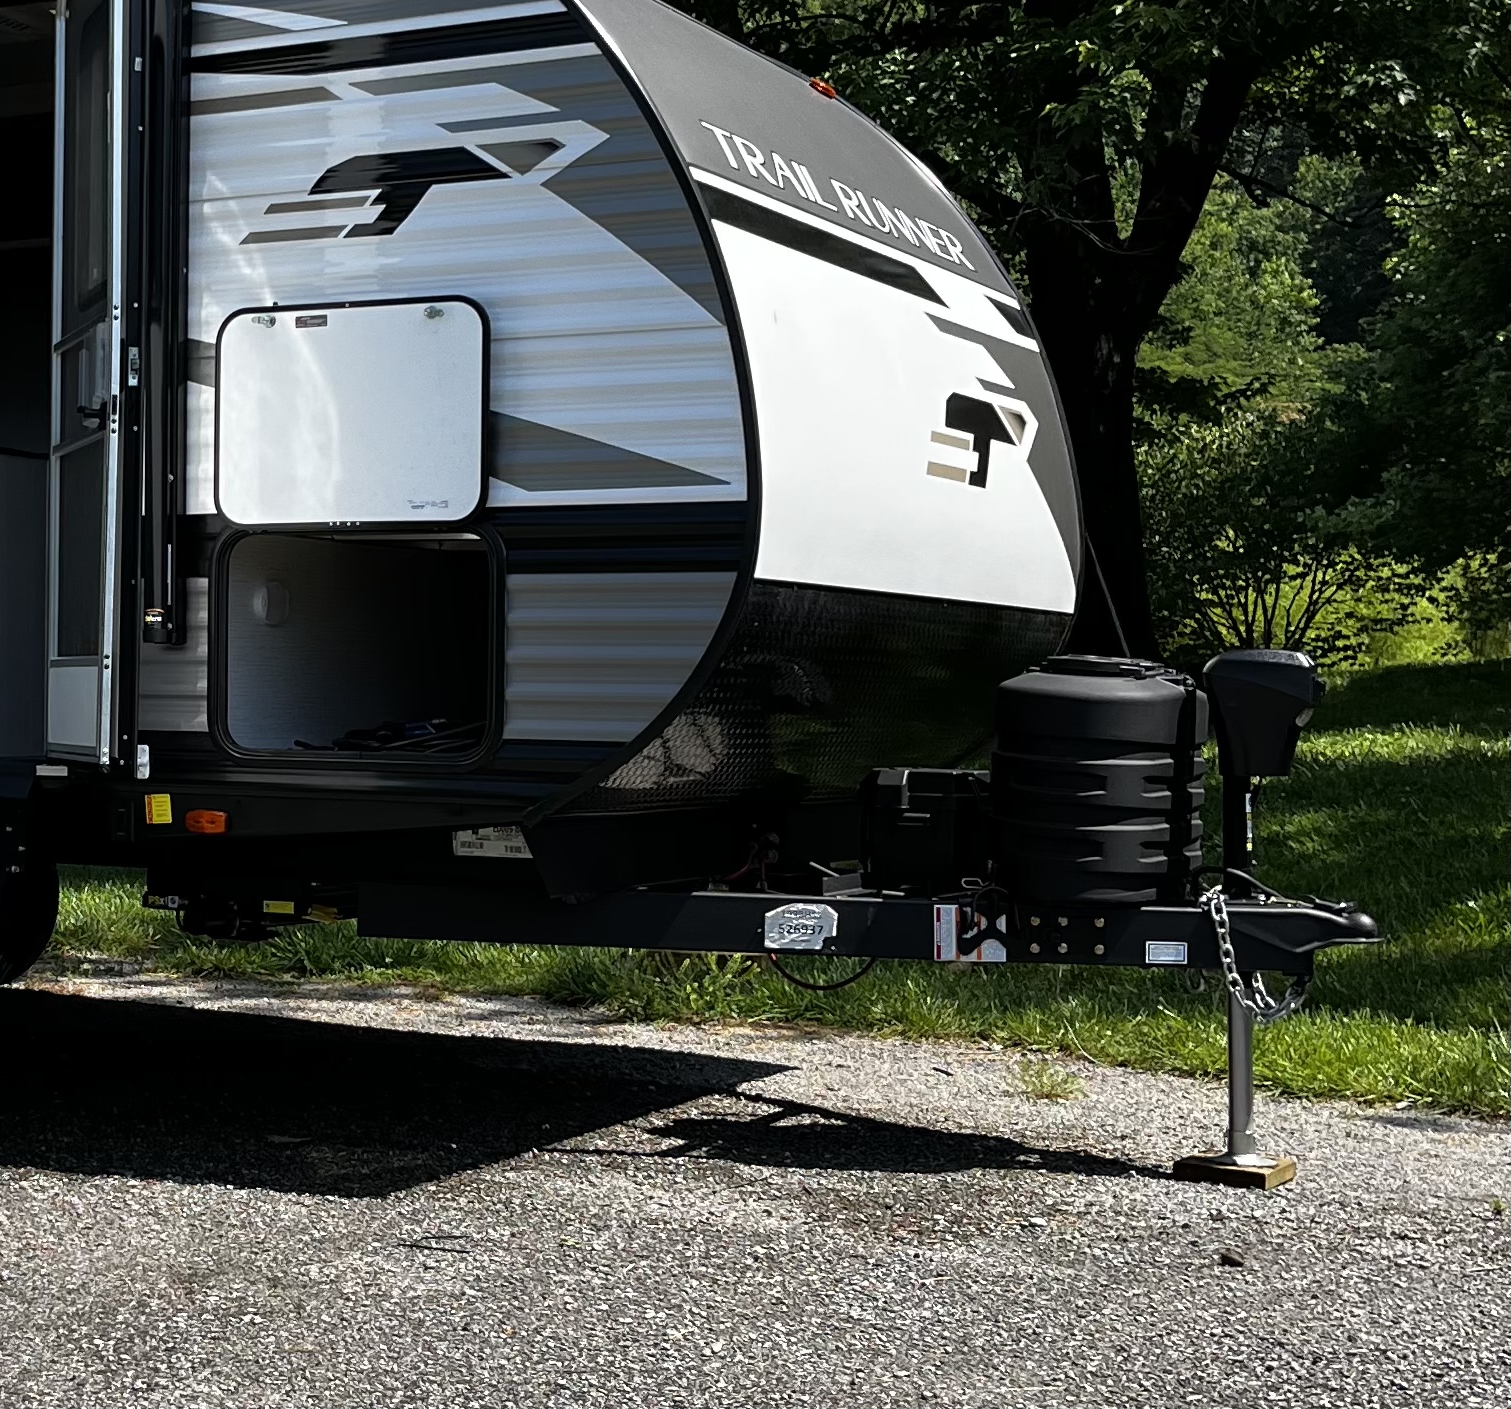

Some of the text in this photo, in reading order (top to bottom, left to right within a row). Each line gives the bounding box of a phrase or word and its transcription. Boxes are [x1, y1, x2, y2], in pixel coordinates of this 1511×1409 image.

[700, 119, 977, 272] TRAIL RUNNER
[778, 923, 824, 935] 526937
